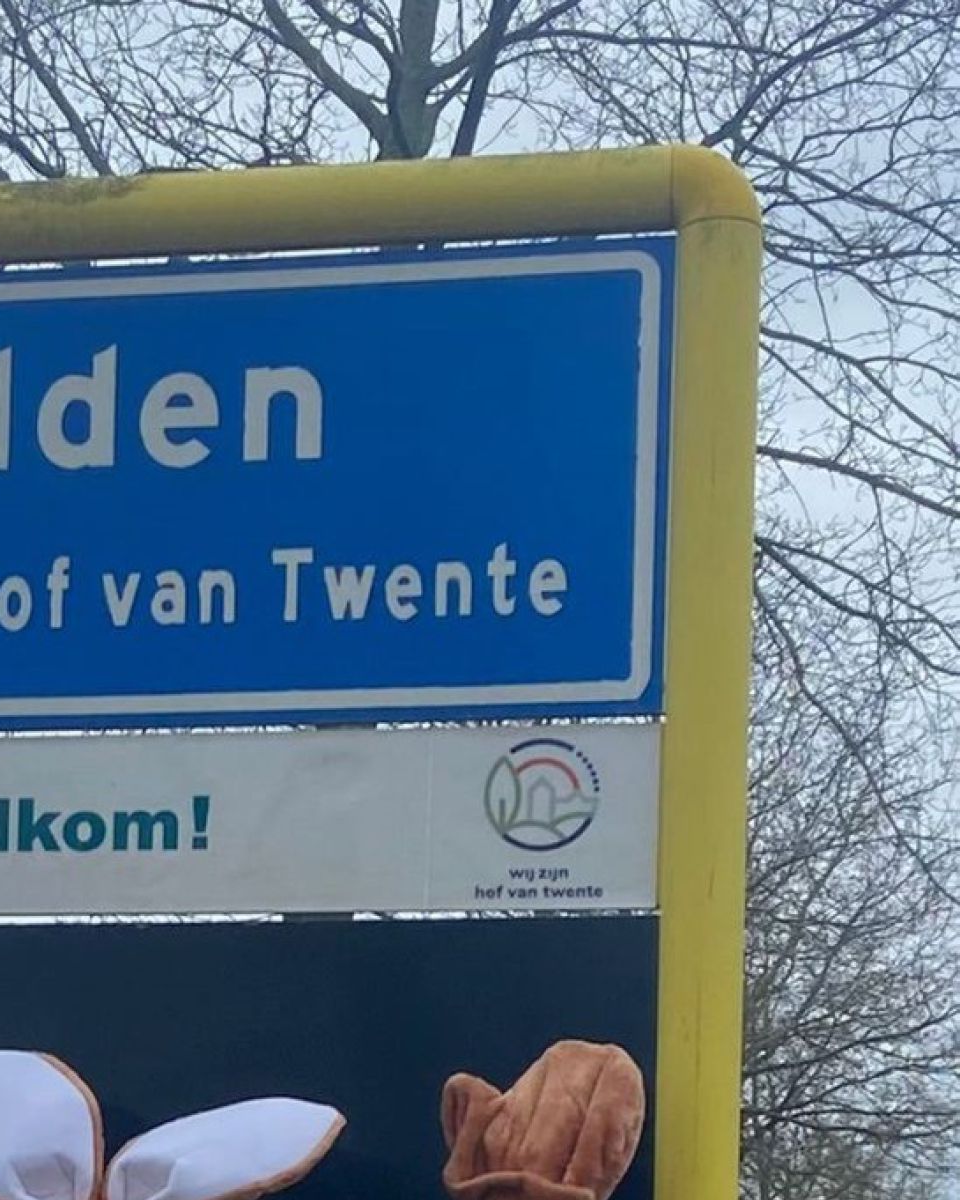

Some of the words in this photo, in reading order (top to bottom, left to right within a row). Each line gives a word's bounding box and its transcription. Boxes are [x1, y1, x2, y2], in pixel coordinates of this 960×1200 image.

[102, 569, 235, 626] van
[272, 542, 568, 622] Twente
[508, 867, 534, 881] wij
[539, 867, 569, 881] zijn
[474, 885, 503, 899] hof
[507, 887, 538, 898] van
[543, 885, 604, 898] twente
